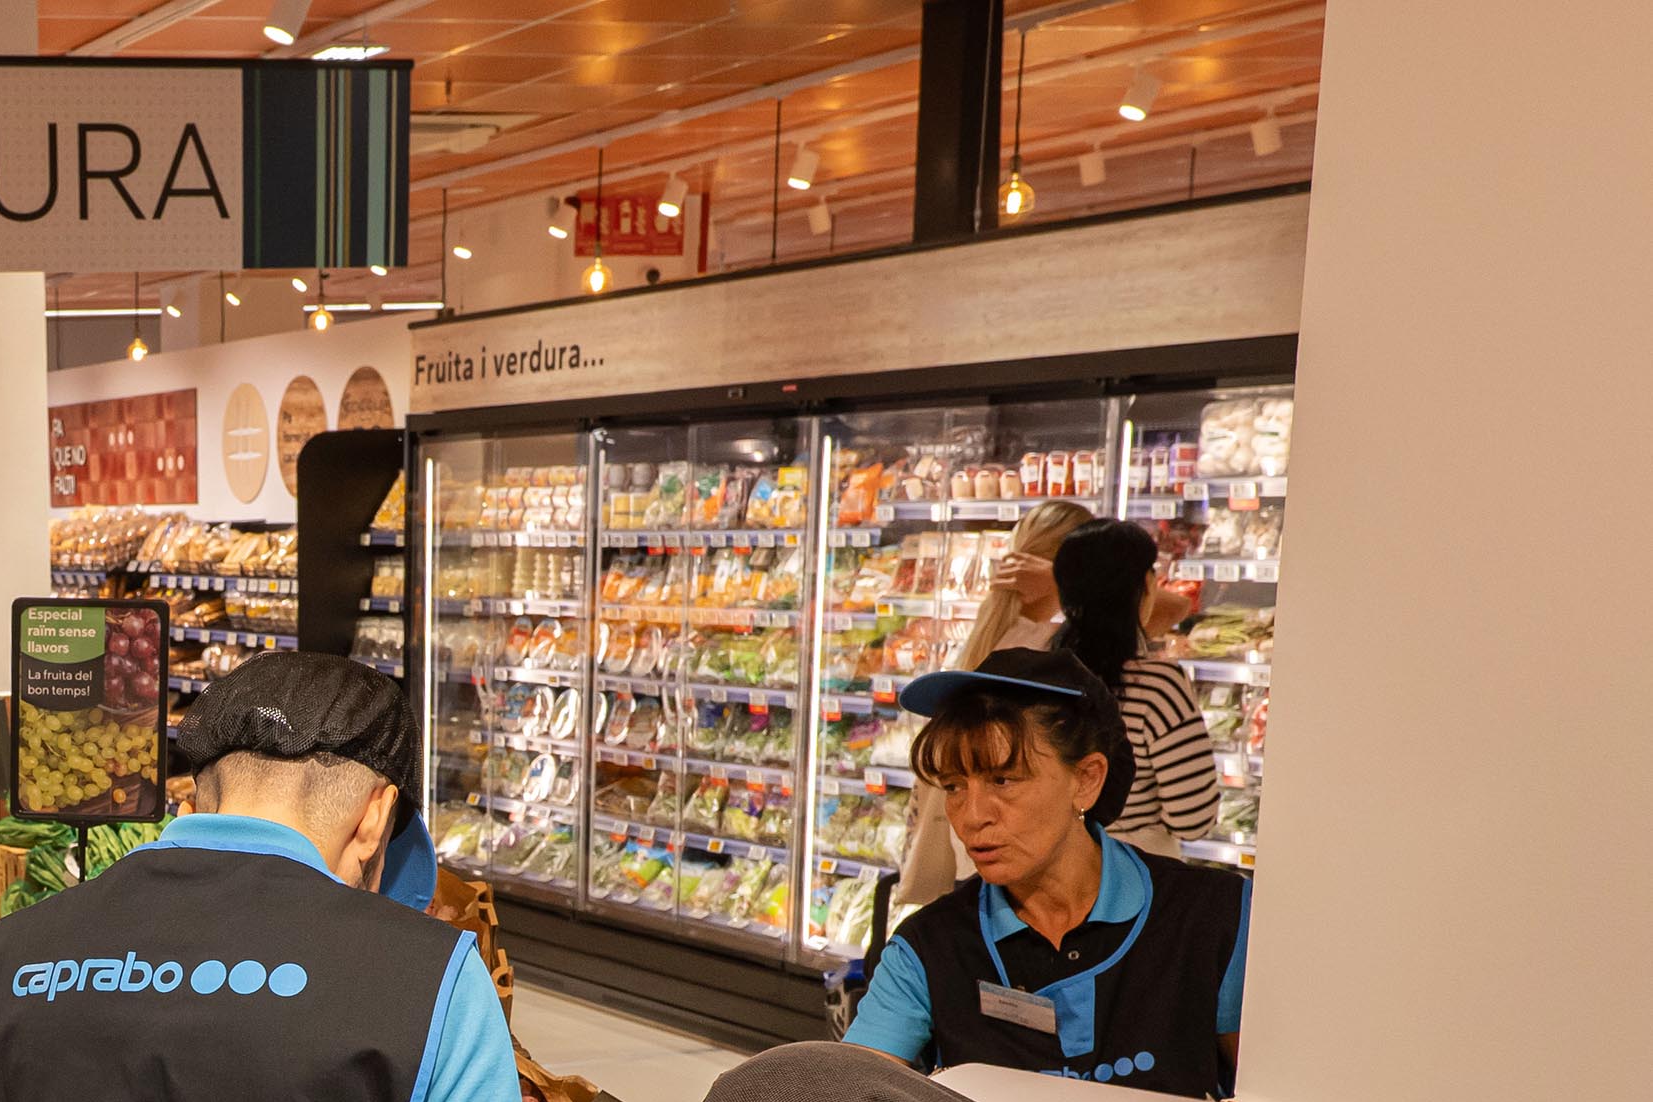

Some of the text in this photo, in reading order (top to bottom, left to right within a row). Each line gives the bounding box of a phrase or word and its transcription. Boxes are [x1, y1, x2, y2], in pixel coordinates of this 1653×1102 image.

[414, 340, 604, 386] Fruita i verdura...
[28, 608, 83, 622] Especial
[27, 625, 97, 638] raïm sense
[27, 641, 70, 654] llavors
[28, 669, 93, 681] La fruita del
[27, 685, 91, 698] bon temps!
[12, 951, 184, 1002] caprabo
